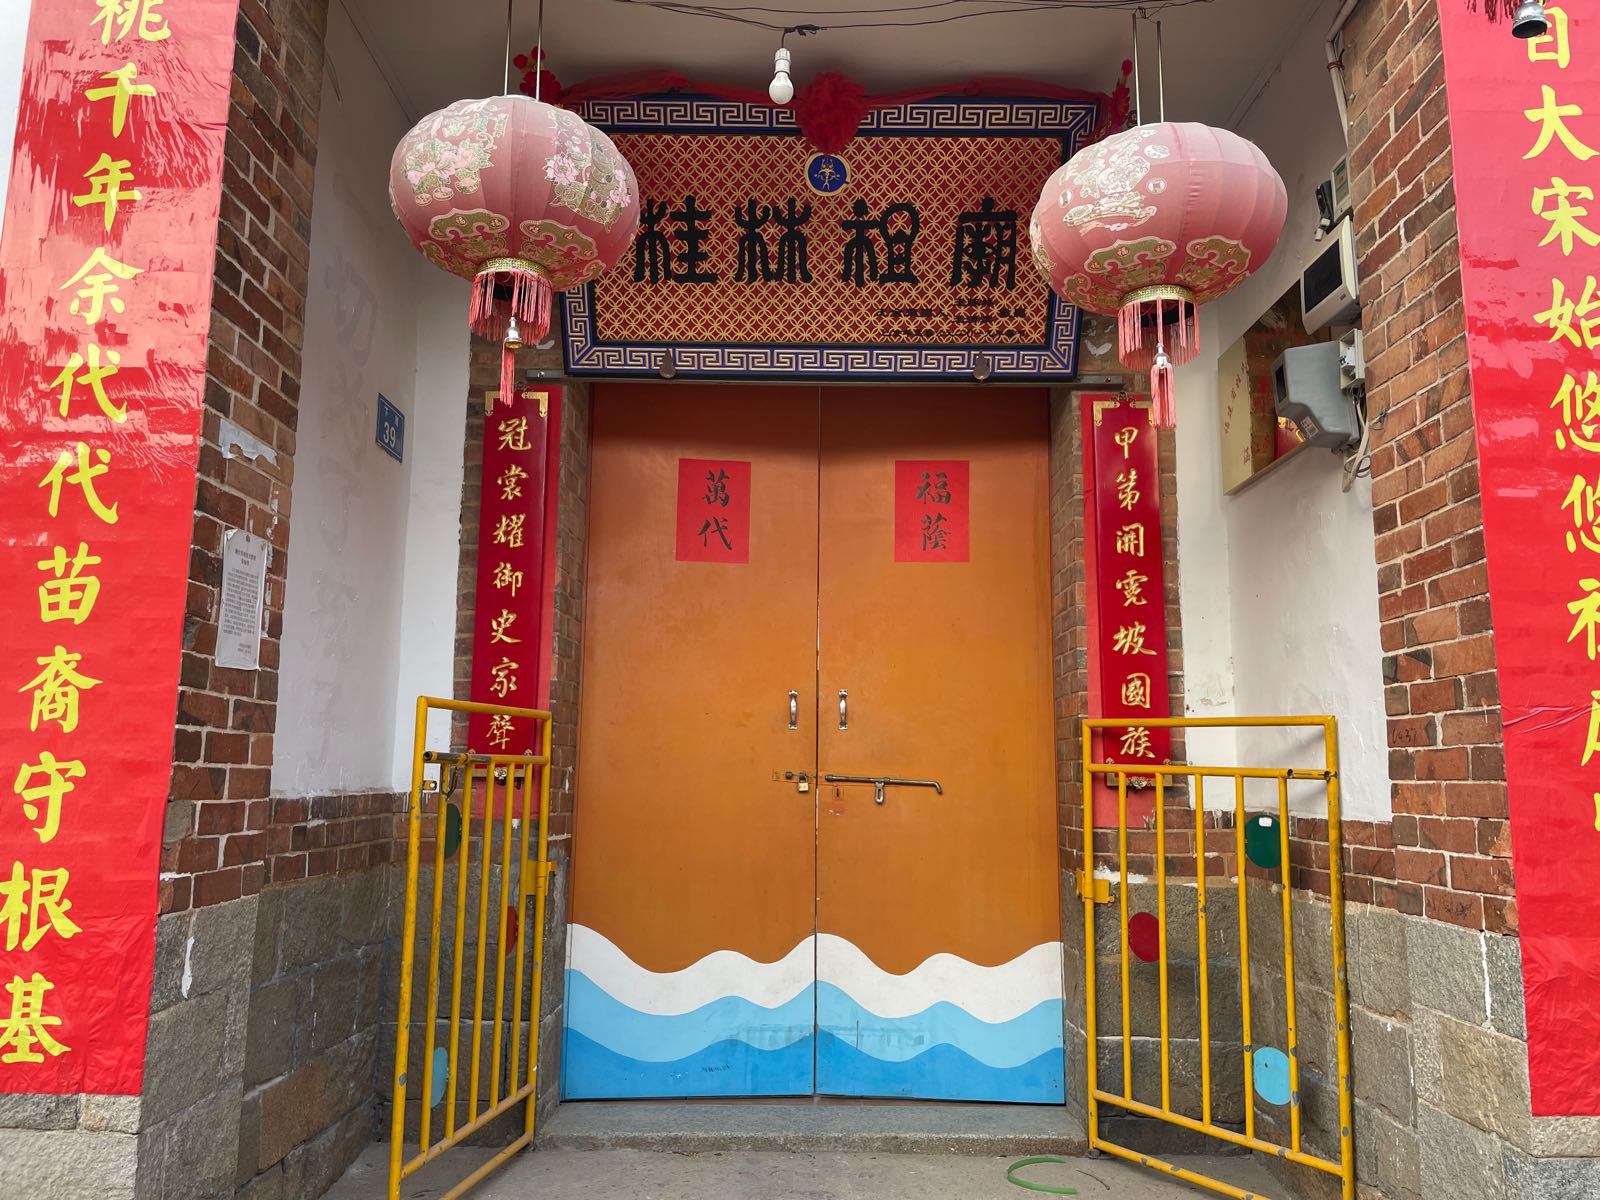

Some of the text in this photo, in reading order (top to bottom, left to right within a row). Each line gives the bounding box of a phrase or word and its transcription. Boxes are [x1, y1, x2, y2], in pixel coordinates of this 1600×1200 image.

[383, 421, 396, 449] 39
[697, 467, 733, 551] 萬代
[916, 470, 952, 552] 福蔭
